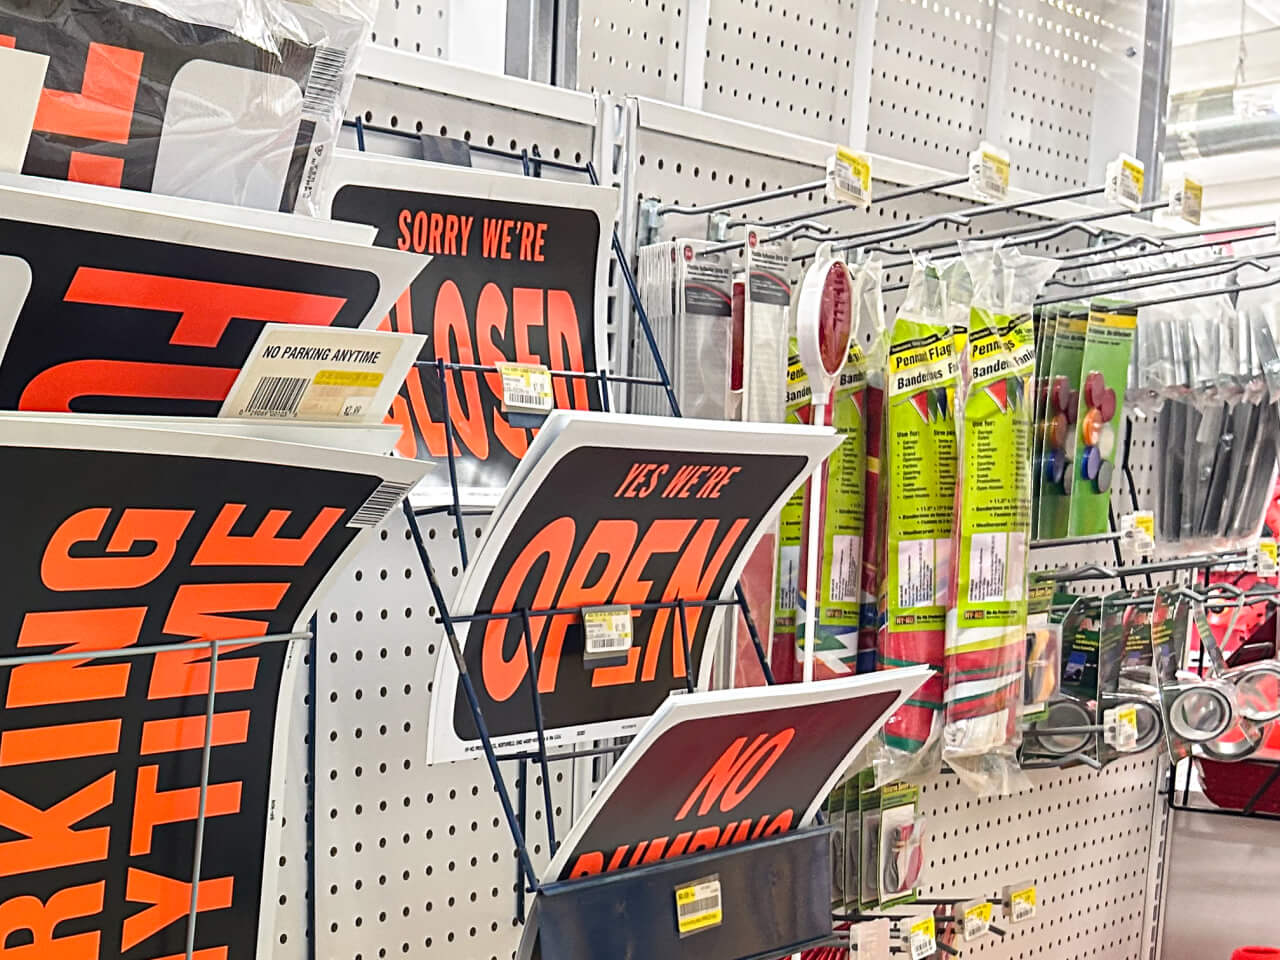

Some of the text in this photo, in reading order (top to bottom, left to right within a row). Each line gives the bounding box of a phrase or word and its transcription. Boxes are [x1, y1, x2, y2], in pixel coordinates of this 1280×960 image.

[398, 209, 549, 263] SORRY WE'RE
[262, 345, 381, 364] NO PARKING ANYTIME
[614, 462, 741, 499] YES WE'RE
[481, 517, 750, 703] OPEN
[675, 727, 795, 822] NO
